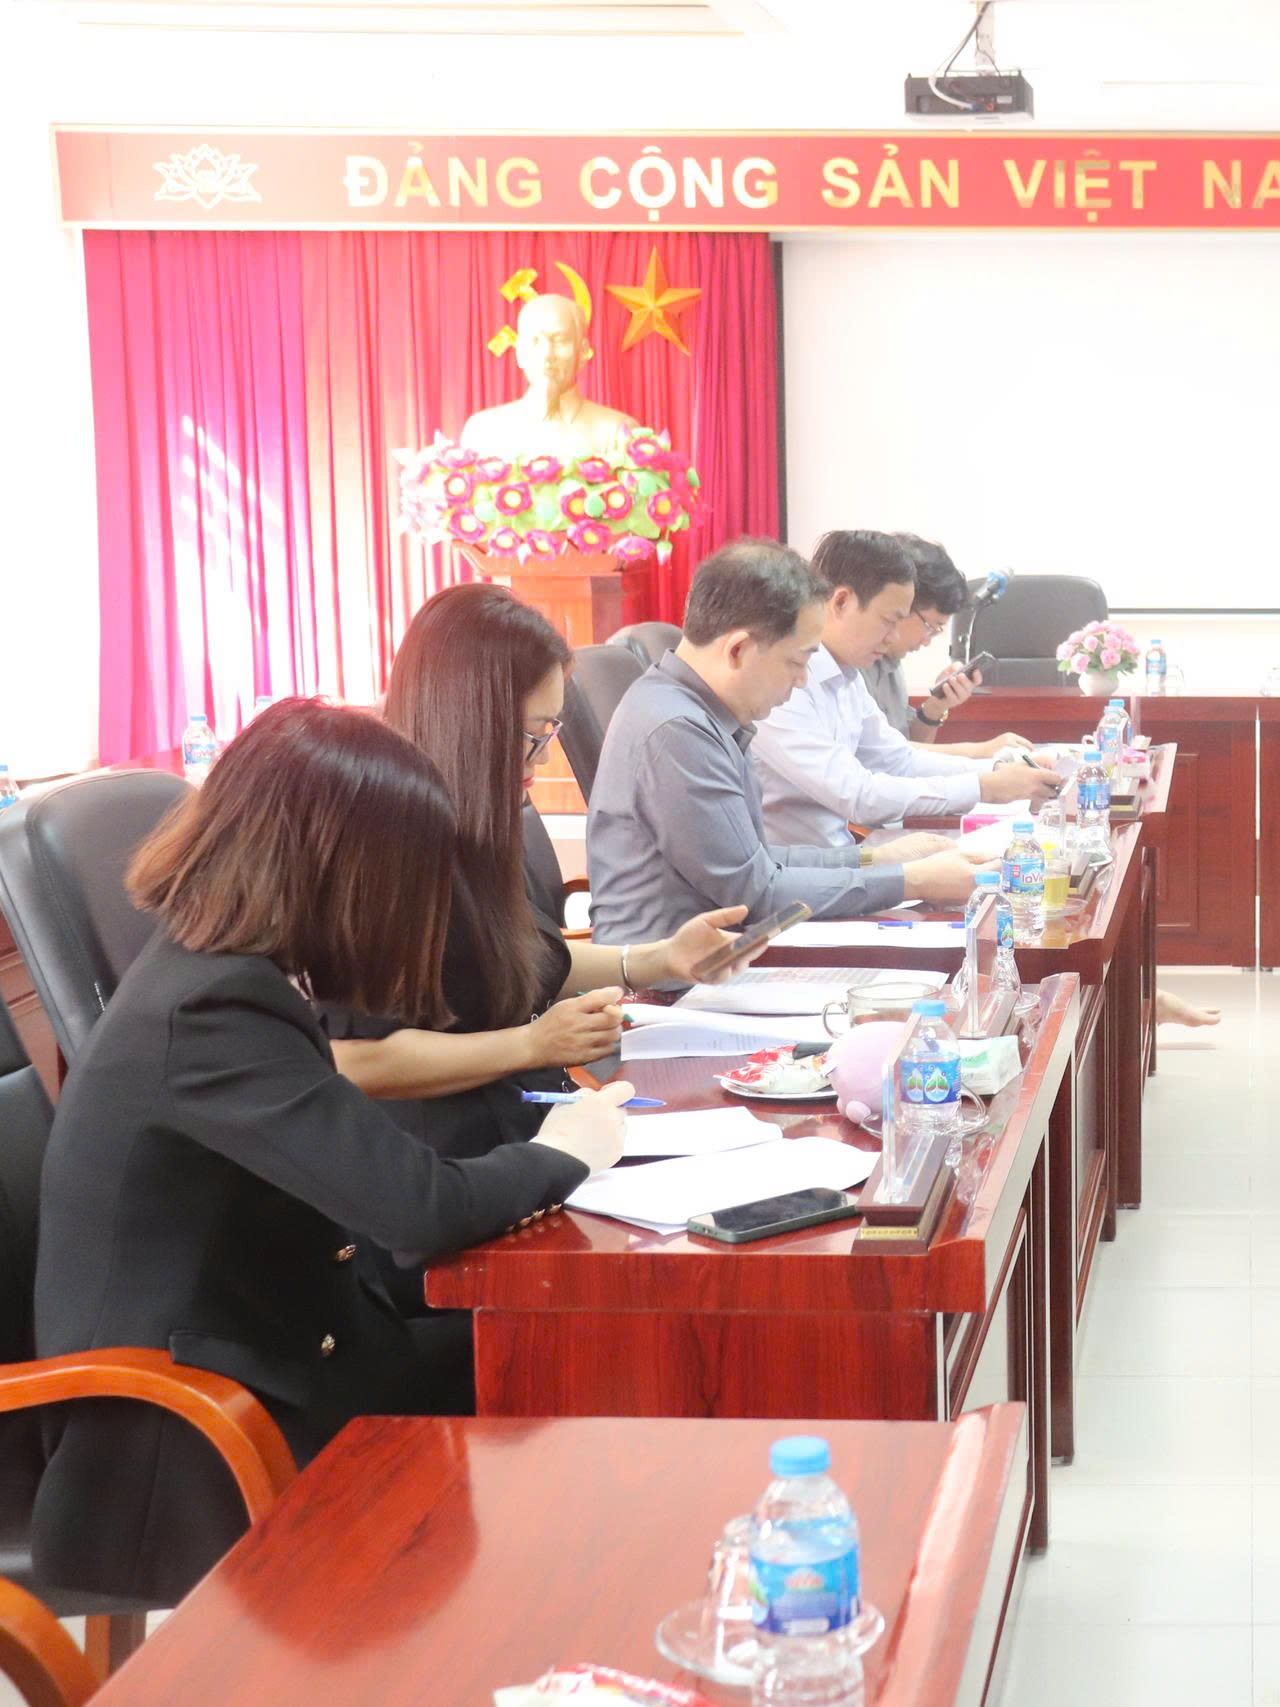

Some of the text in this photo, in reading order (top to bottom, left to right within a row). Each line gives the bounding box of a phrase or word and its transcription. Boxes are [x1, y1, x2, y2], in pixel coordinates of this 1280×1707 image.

[344, 142, 545, 208] ĐẢNG
[579, 146, 780, 222] CỘNG
[822, 142, 962, 210] SẢN
[1004, 150, 1157, 222] VIỆT
